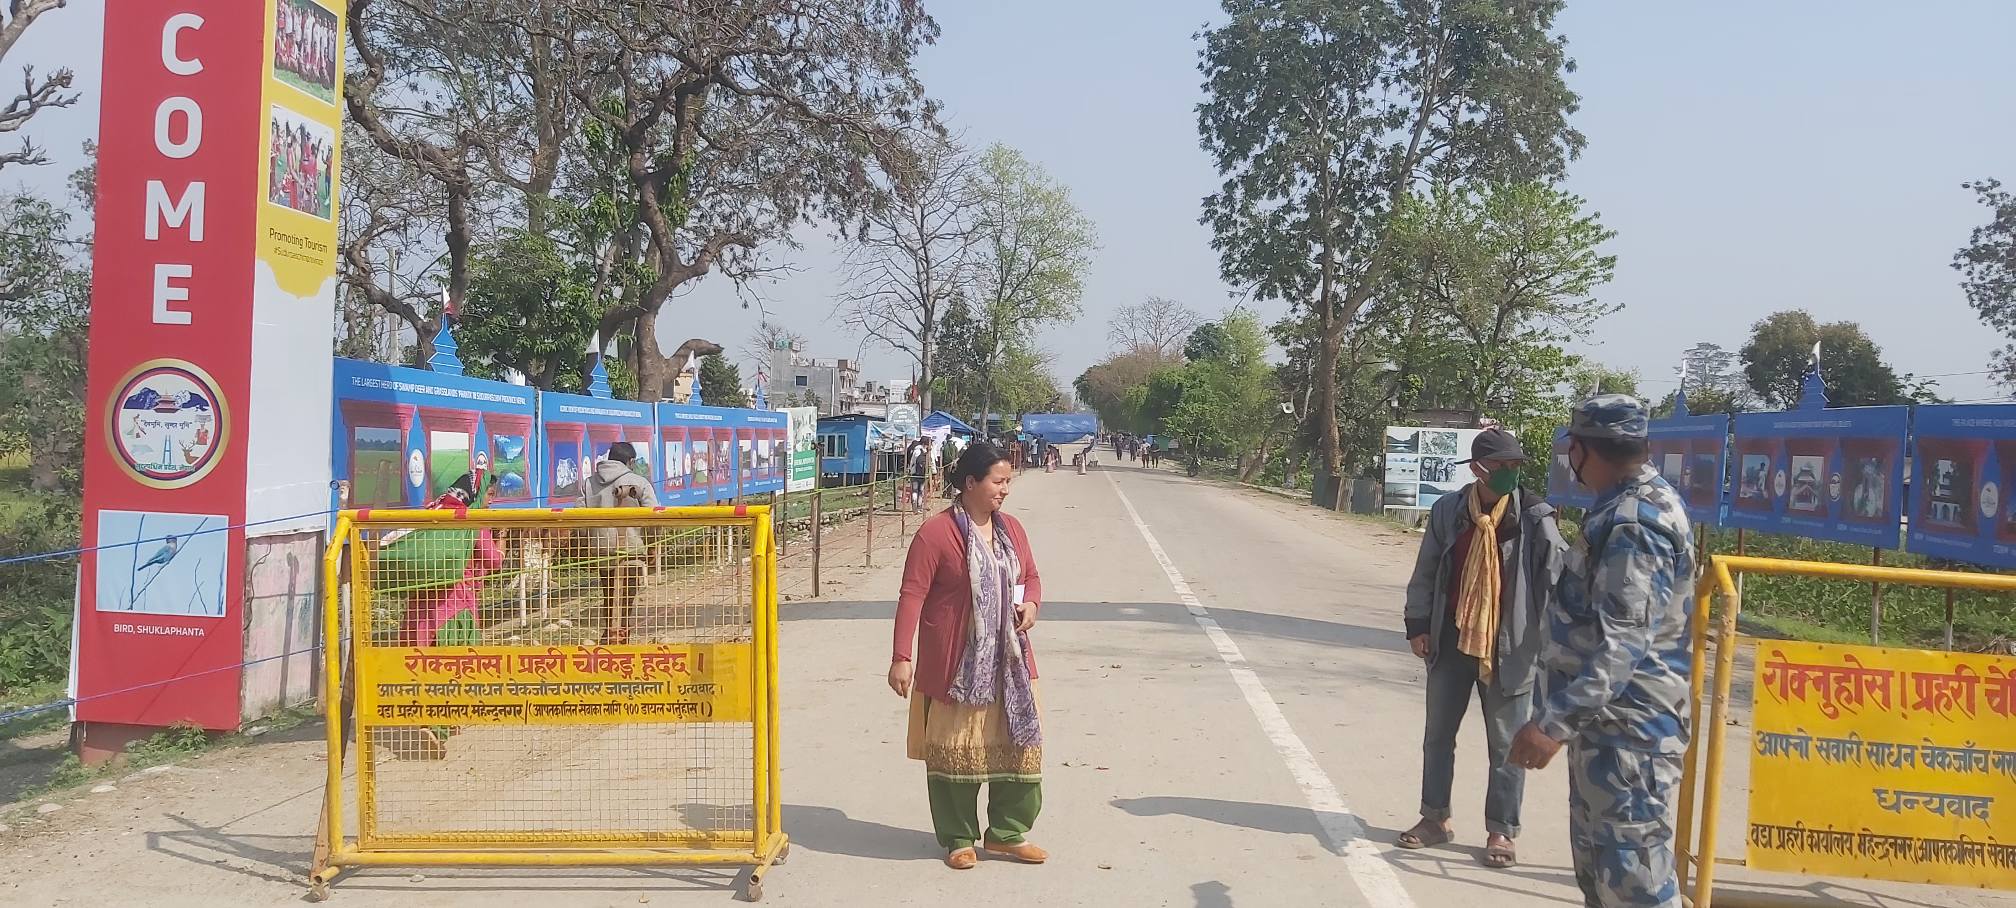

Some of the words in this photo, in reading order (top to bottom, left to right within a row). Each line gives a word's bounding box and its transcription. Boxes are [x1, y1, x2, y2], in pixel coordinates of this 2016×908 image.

[269, 227, 304, 249] Promoting
[304, 237, 328, 253] Tourism
[352, 376, 361, 387] THE
[361, 378, 380, 388] LARGEST
[114, 624, 135, 634] BIRD,
[137, 625, 204, 636] SHUKLAPHANTA
[518, 647, 567, 679] प्रहरी
[377, 679, 421, 697] आफ्नो
[425, 679, 462, 698] सवारी
[464, 683, 504, 698] साधन
[1911, 664, 1981, 723] प्रहरी
[377, 704, 394, 719] वडा
[397, 700, 424, 722] प्रहरी
[603, 700, 623, 716] लागि
[641, 702, 665, 716] डायल
[1754, 727, 1813, 761] आफ्नो
[1815, 731, 1864, 768] सवारी
[1865, 741, 1919, 773] साधन
[1920, 737, 1991, 775] चेकजाँच
[1872, 788, 1994, 830] धन्यवाद
[1751, 823, 1775, 849] वडा
[1776, 820, 1806, 856] प्रहरी
